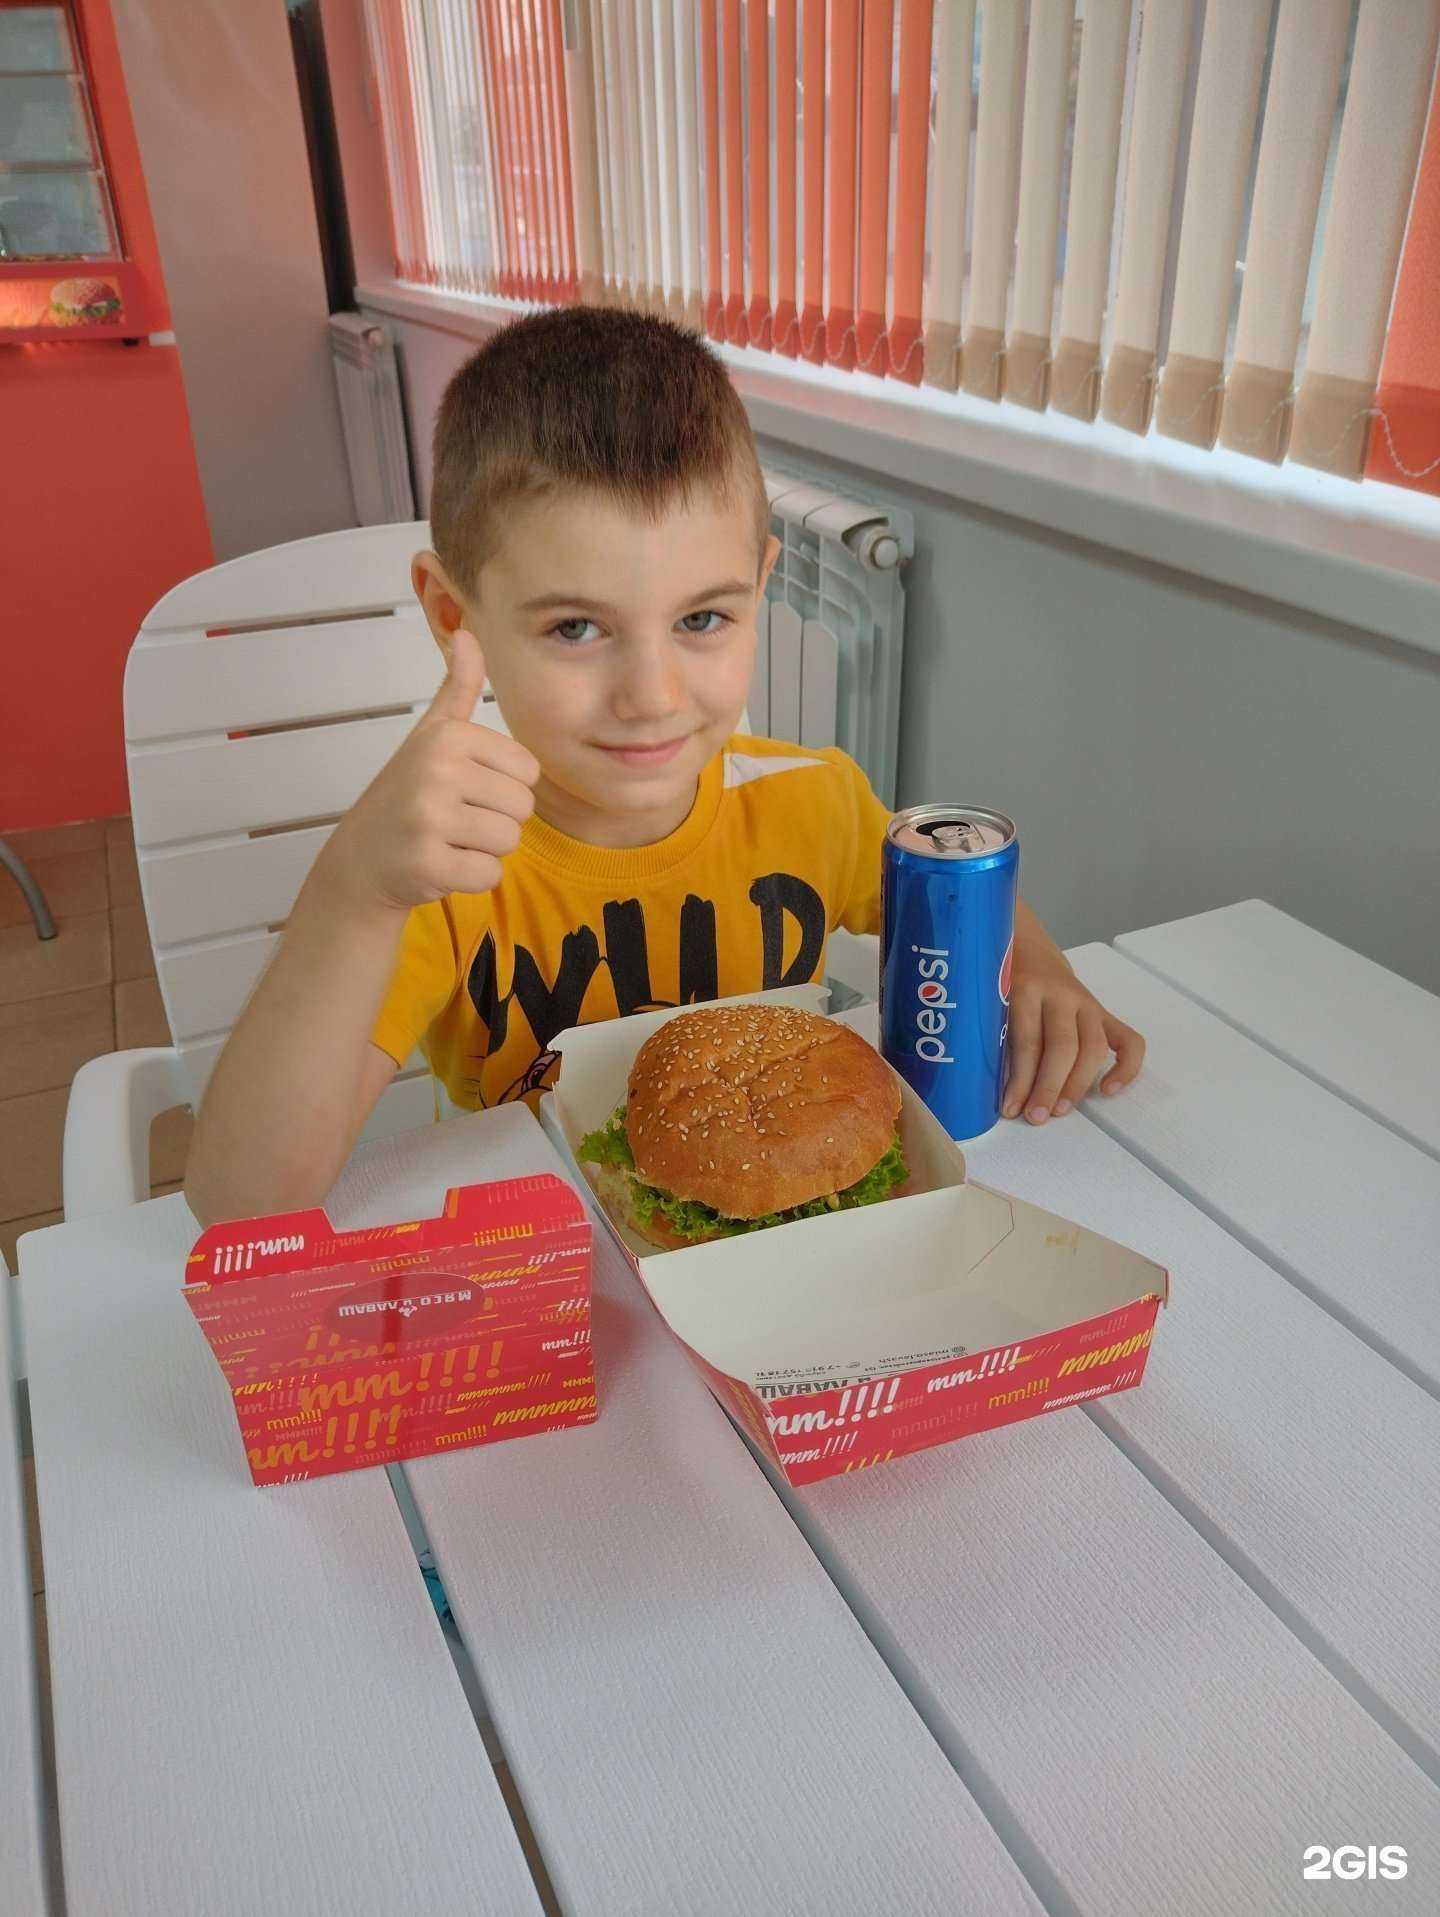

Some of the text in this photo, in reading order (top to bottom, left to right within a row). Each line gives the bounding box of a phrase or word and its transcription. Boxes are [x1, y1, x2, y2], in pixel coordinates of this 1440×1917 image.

[911, 945, 957, 1063] pepsi
[420, 1289, 472, 1307] МЯСО
[338, 1301, 398, 1318] ЛАВАШ
